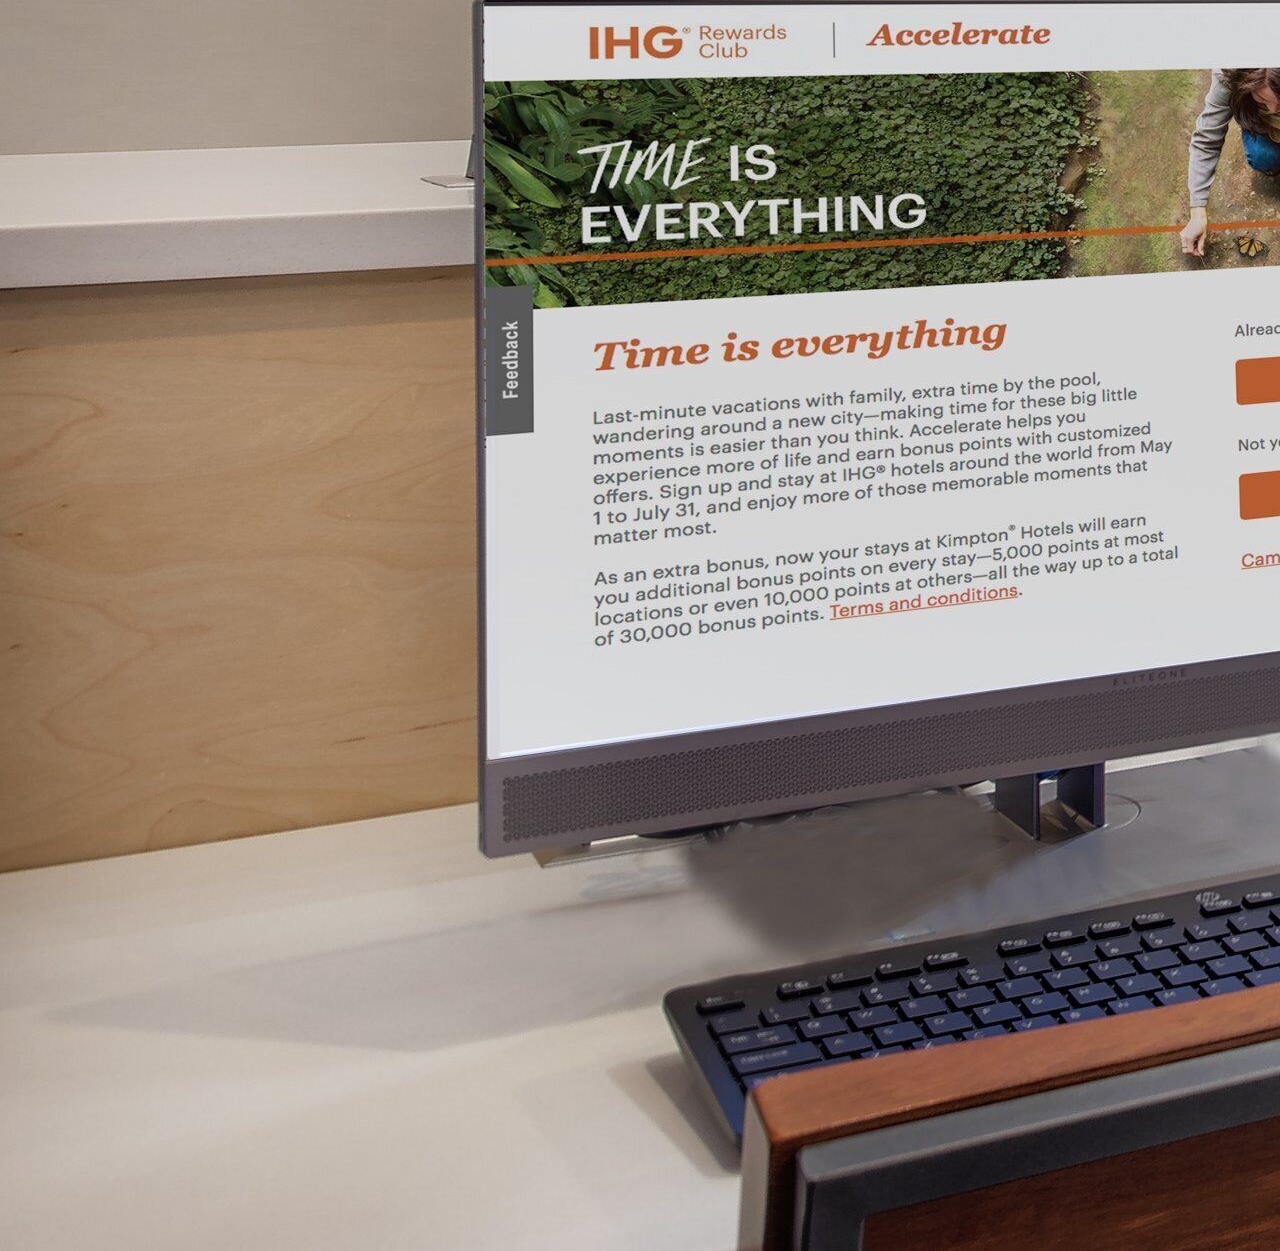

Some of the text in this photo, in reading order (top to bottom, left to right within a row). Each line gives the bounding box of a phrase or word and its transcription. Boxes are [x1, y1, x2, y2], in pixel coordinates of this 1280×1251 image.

[699, 24, 787, 41] Rewards
[699, 42, 749, 59] Club
[865, 22, 1051, 47] Accelerate
[578, 138, 777, 193] TIME IS
[582, 193, 927, 244] EVERYTHING
[502, 320, 519, 399] Feedback
[593, 317, 1007, 371] Time is everything
[593, 371, 1101, 425] Last-minute vacations with family, extra time by the pool,
[1238, 438, 1266, 452] Not
[593, 459, 1148, 525] 1 to July 31, and enjoy more of those memorable moments that
[594, 586, 1023, 647] of 30,000 bonus points. Terms and conditions.
